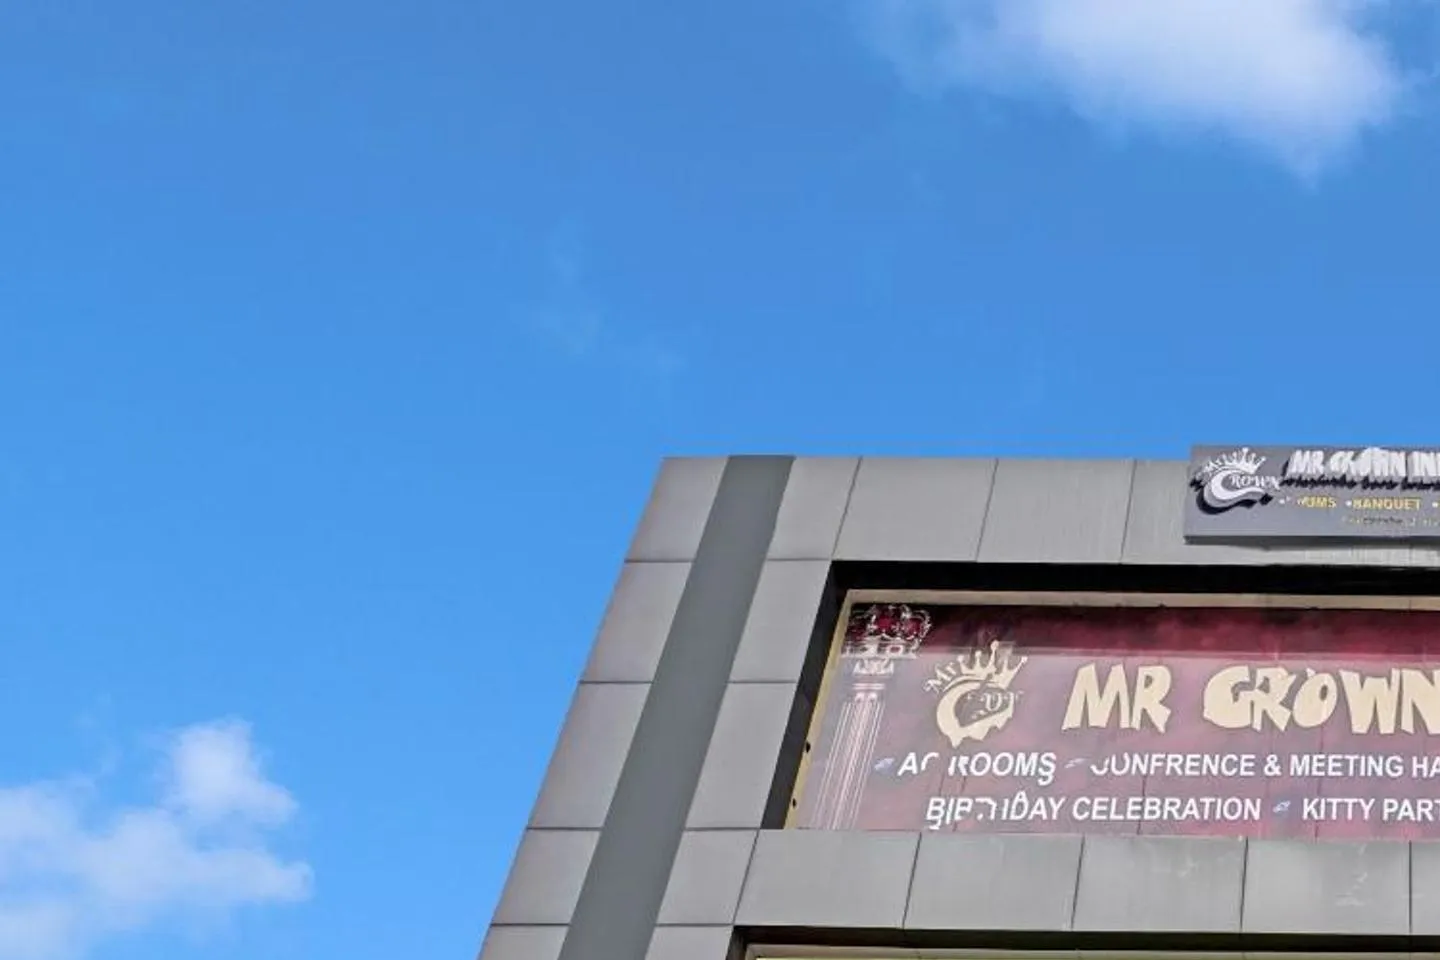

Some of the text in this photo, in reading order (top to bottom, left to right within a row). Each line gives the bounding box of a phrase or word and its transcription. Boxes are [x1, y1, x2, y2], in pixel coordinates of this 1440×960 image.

[1286, 450, 1326, 477] MR
[1286, 496, 1337, 508] OMS
[1061, 662, 1173, 734] MR
[947, 752, 1057, 777] ROOMS
[1263, 754, 1282, 777] &
[1289, 754, 1404, 777] MEETING
[1072, 797, 1262, 821] CELEBRATION
[1302, 798, 1375, 821] KITTY
